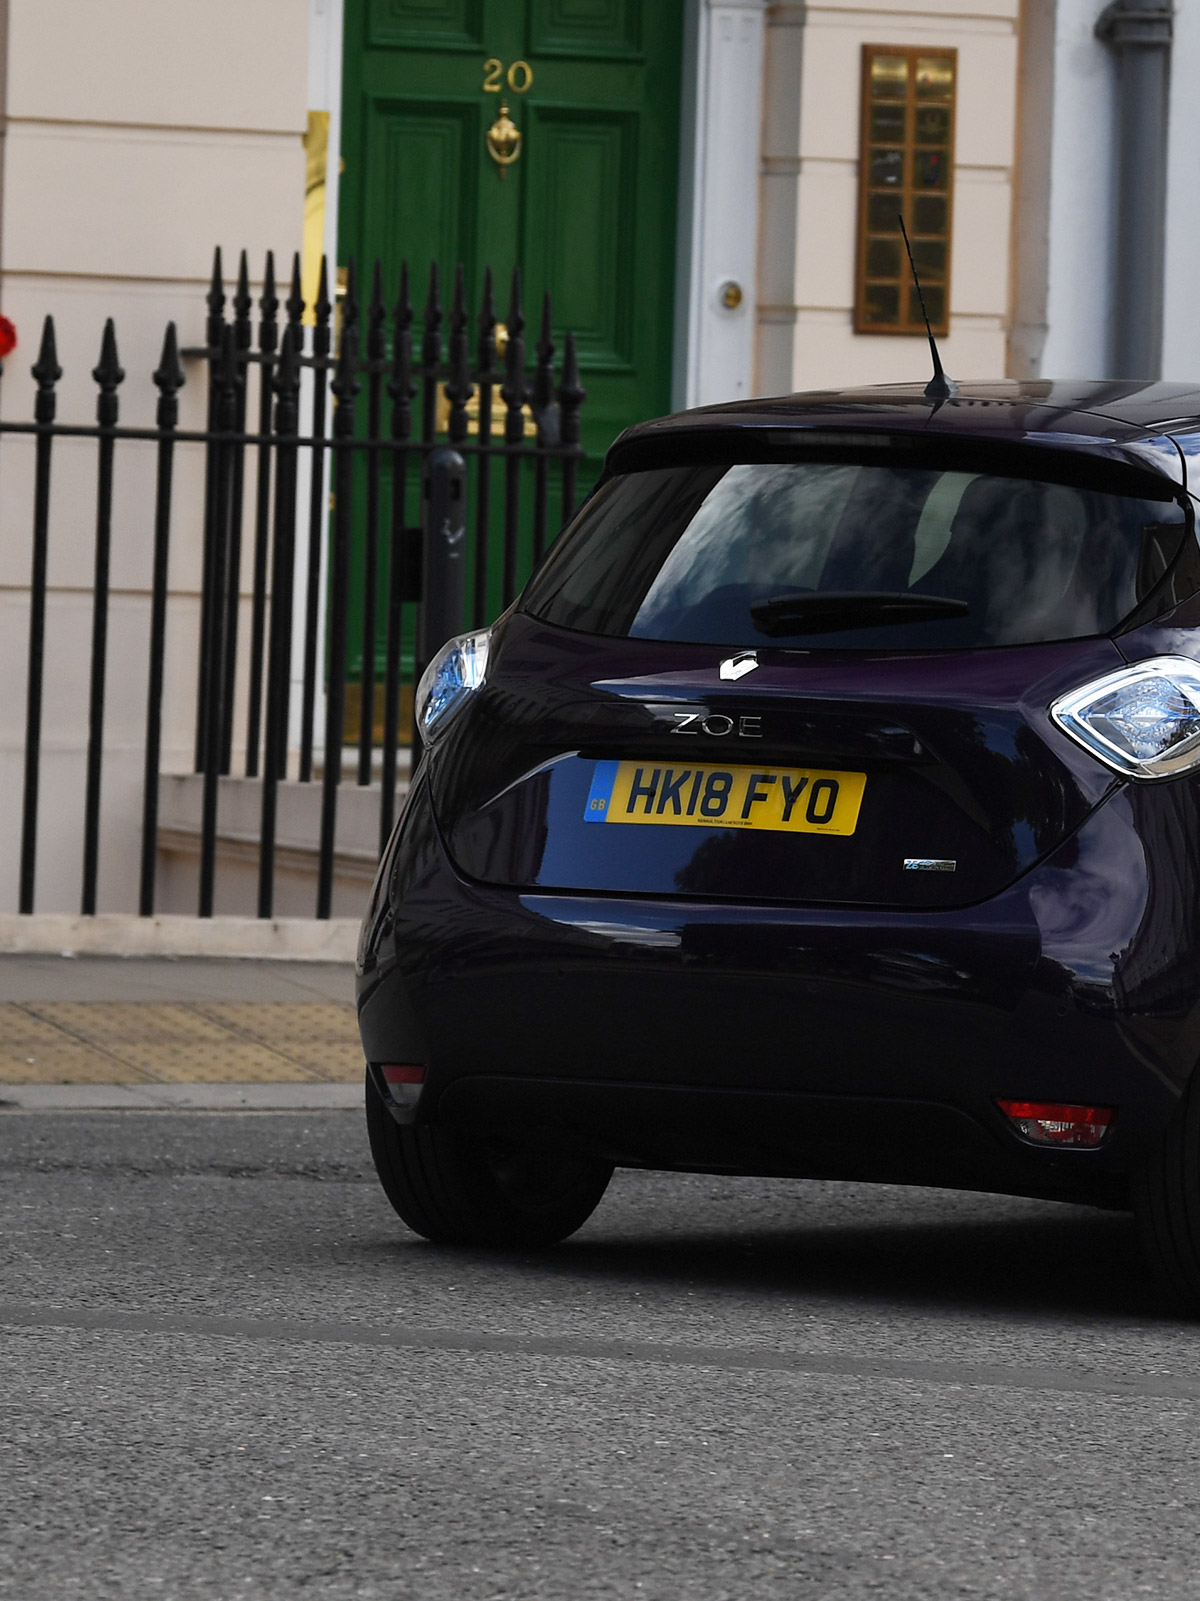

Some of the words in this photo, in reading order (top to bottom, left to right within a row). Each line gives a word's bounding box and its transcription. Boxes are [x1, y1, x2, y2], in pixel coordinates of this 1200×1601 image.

[483, 58, 533, 94] 20
[670, 712, 763, 738] ZOE
[590, 798, 606, 811] GB
[626, 768, 734, 817] HK18
[741, 774, 840, 825] FYO
